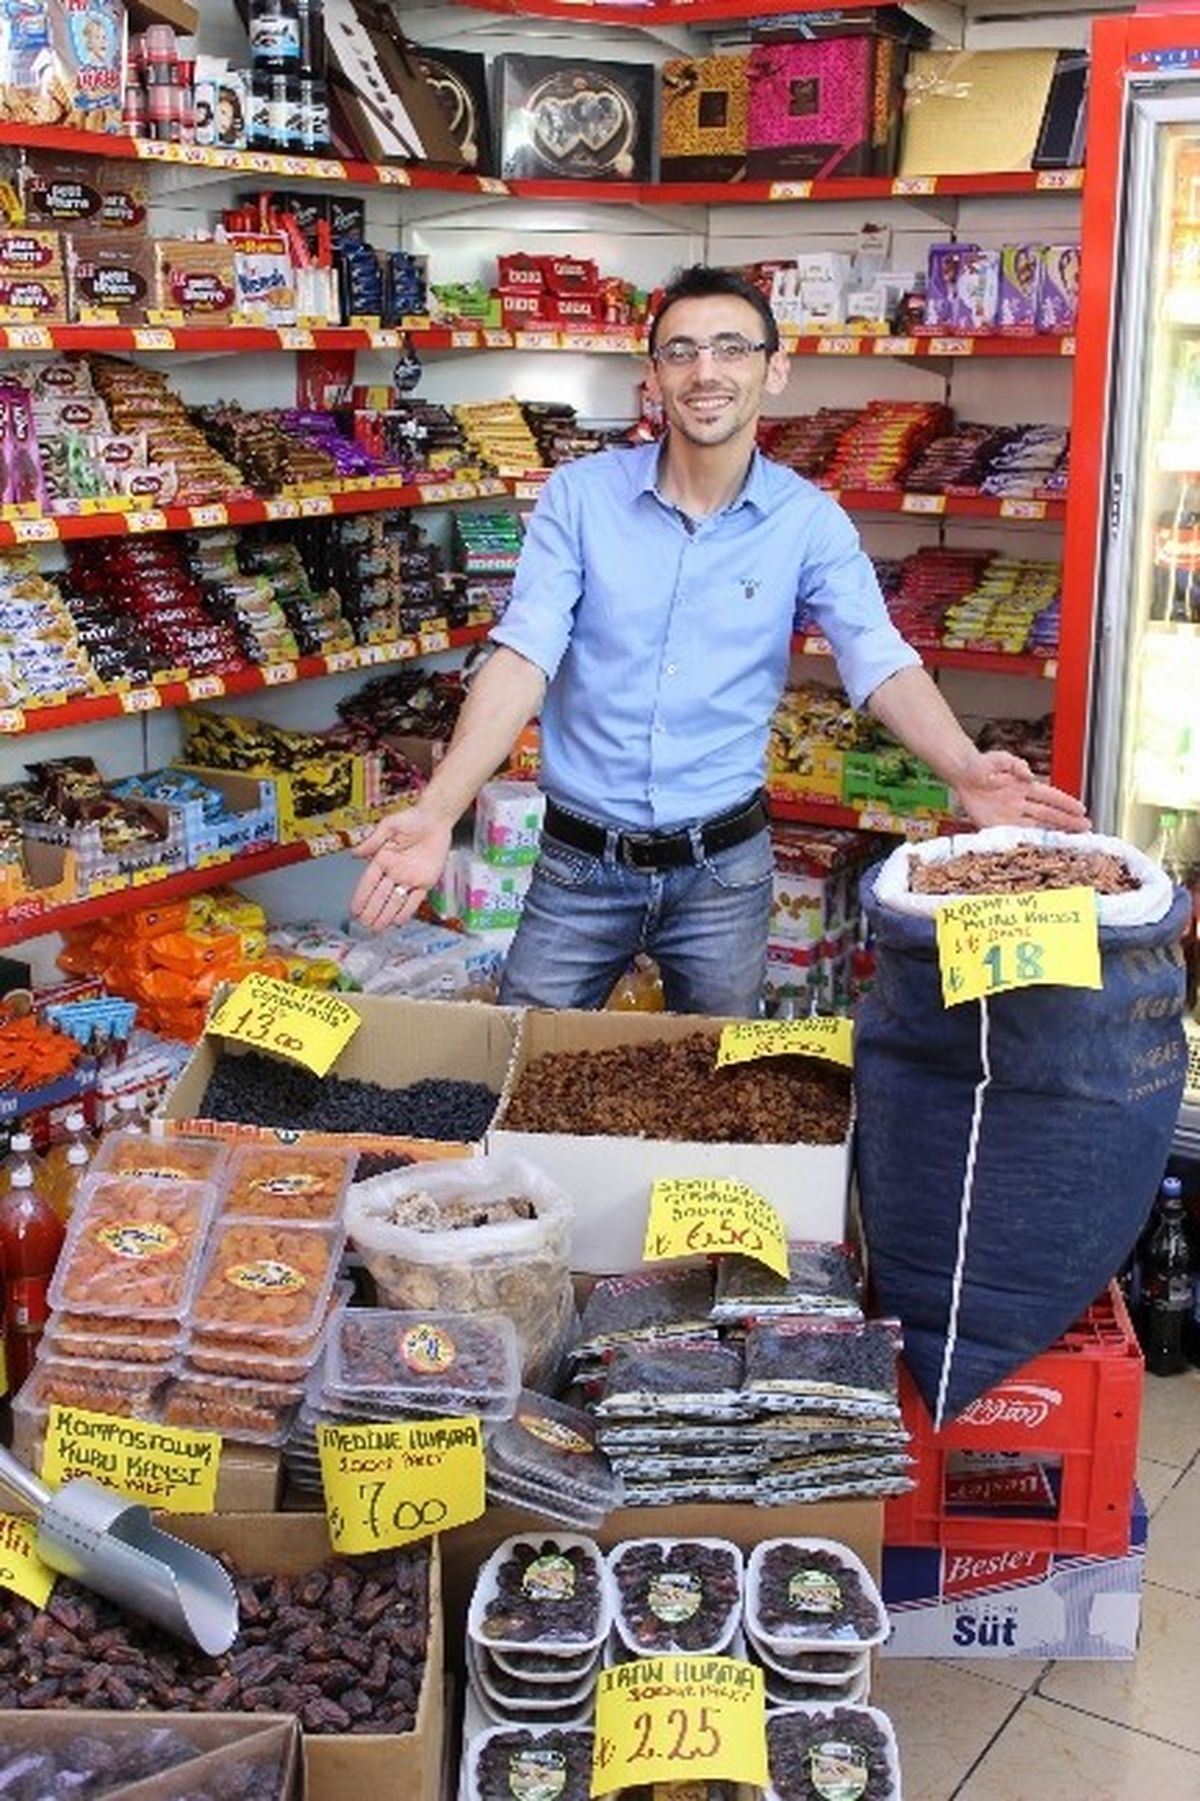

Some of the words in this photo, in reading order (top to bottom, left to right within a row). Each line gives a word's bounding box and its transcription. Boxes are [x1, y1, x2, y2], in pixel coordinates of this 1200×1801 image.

[983, 941, 1044, 988] 18
[953, 1615, 1018, 1647] Süt
[626, 1707, 722, 1763] 2.25
